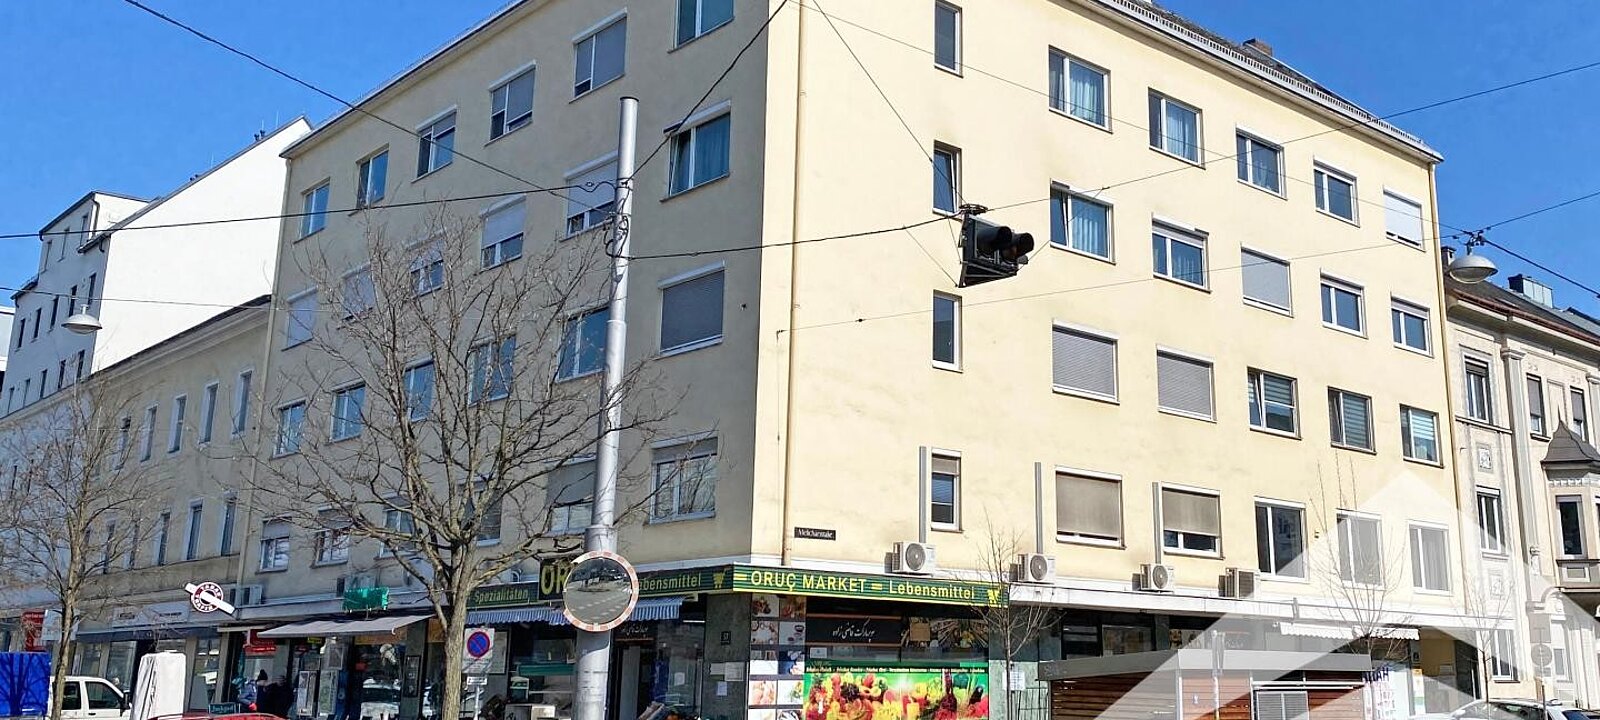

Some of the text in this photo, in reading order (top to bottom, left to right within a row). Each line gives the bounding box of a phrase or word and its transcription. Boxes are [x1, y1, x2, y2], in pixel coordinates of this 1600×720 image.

[751, 571, 975, 599] ORUÇ MARKET Lebensmittel
[475, 588, 529, 605] Spezialitäten
